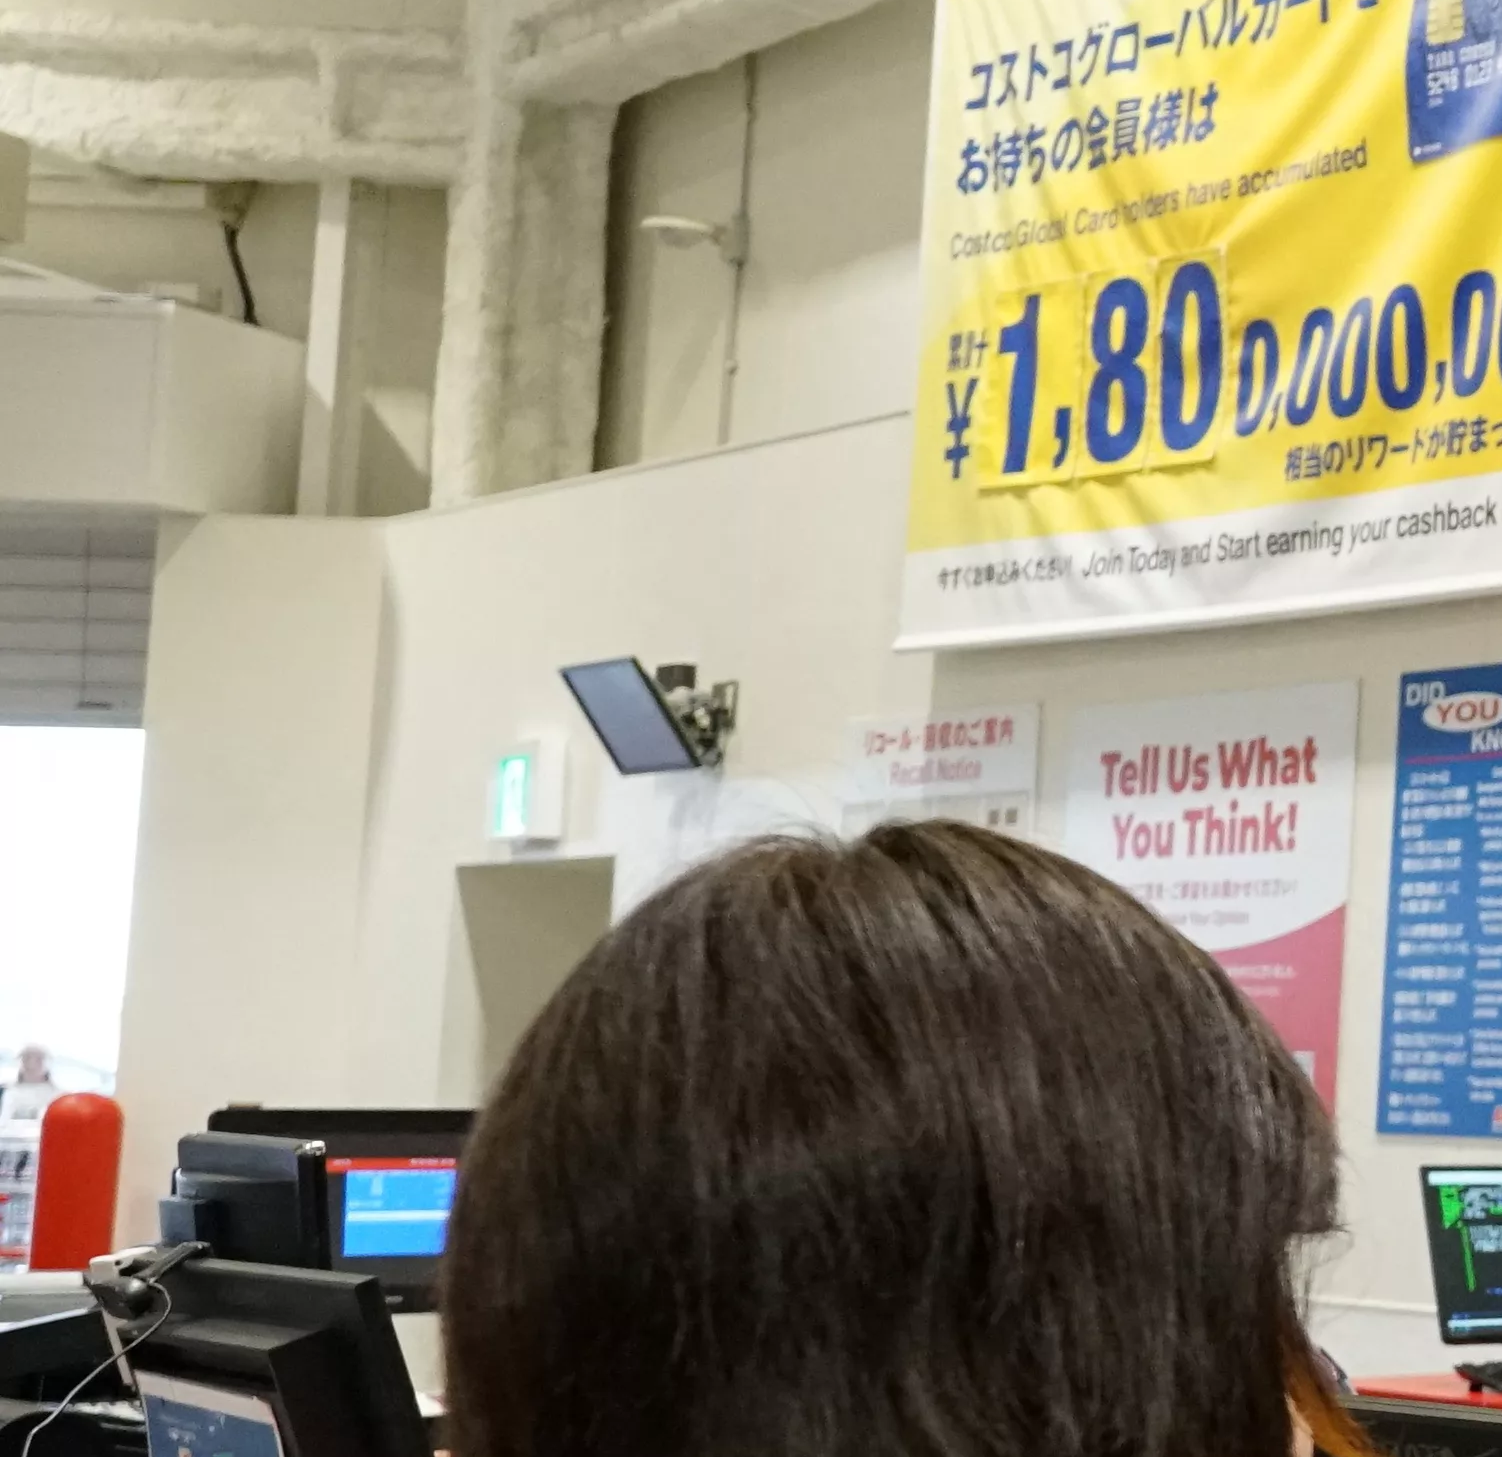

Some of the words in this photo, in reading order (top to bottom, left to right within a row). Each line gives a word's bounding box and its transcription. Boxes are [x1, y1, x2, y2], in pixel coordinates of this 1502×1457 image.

[956, 83, 1221, 197] お持ちの会員様は
[1185, 175, 1231, 209] have
[1236, 137, 1369, 198] accumulated
[1081, 549, 1123, 579] Join
[1127, 544, 1178, 578] Today
[1180, 536, 1212, 567] and
[1216, 530, 1262, 563] Start
[1266, 519, 1345, 557] earning
[1348, 513, 1393, 554] your
[1395, 493, 1498, 539] cashback
[1404, 681, 1446, 708] DID
[1436, 698, 1502, 725] YOU
[1100, 746, 1160, 798] Tell
[1167, 743, 1210, 793] Us
[1215, 736, 1319, 790] What
[1112, 812, 1175, 861] You
[1184, 801, 1298, 852] Think!
